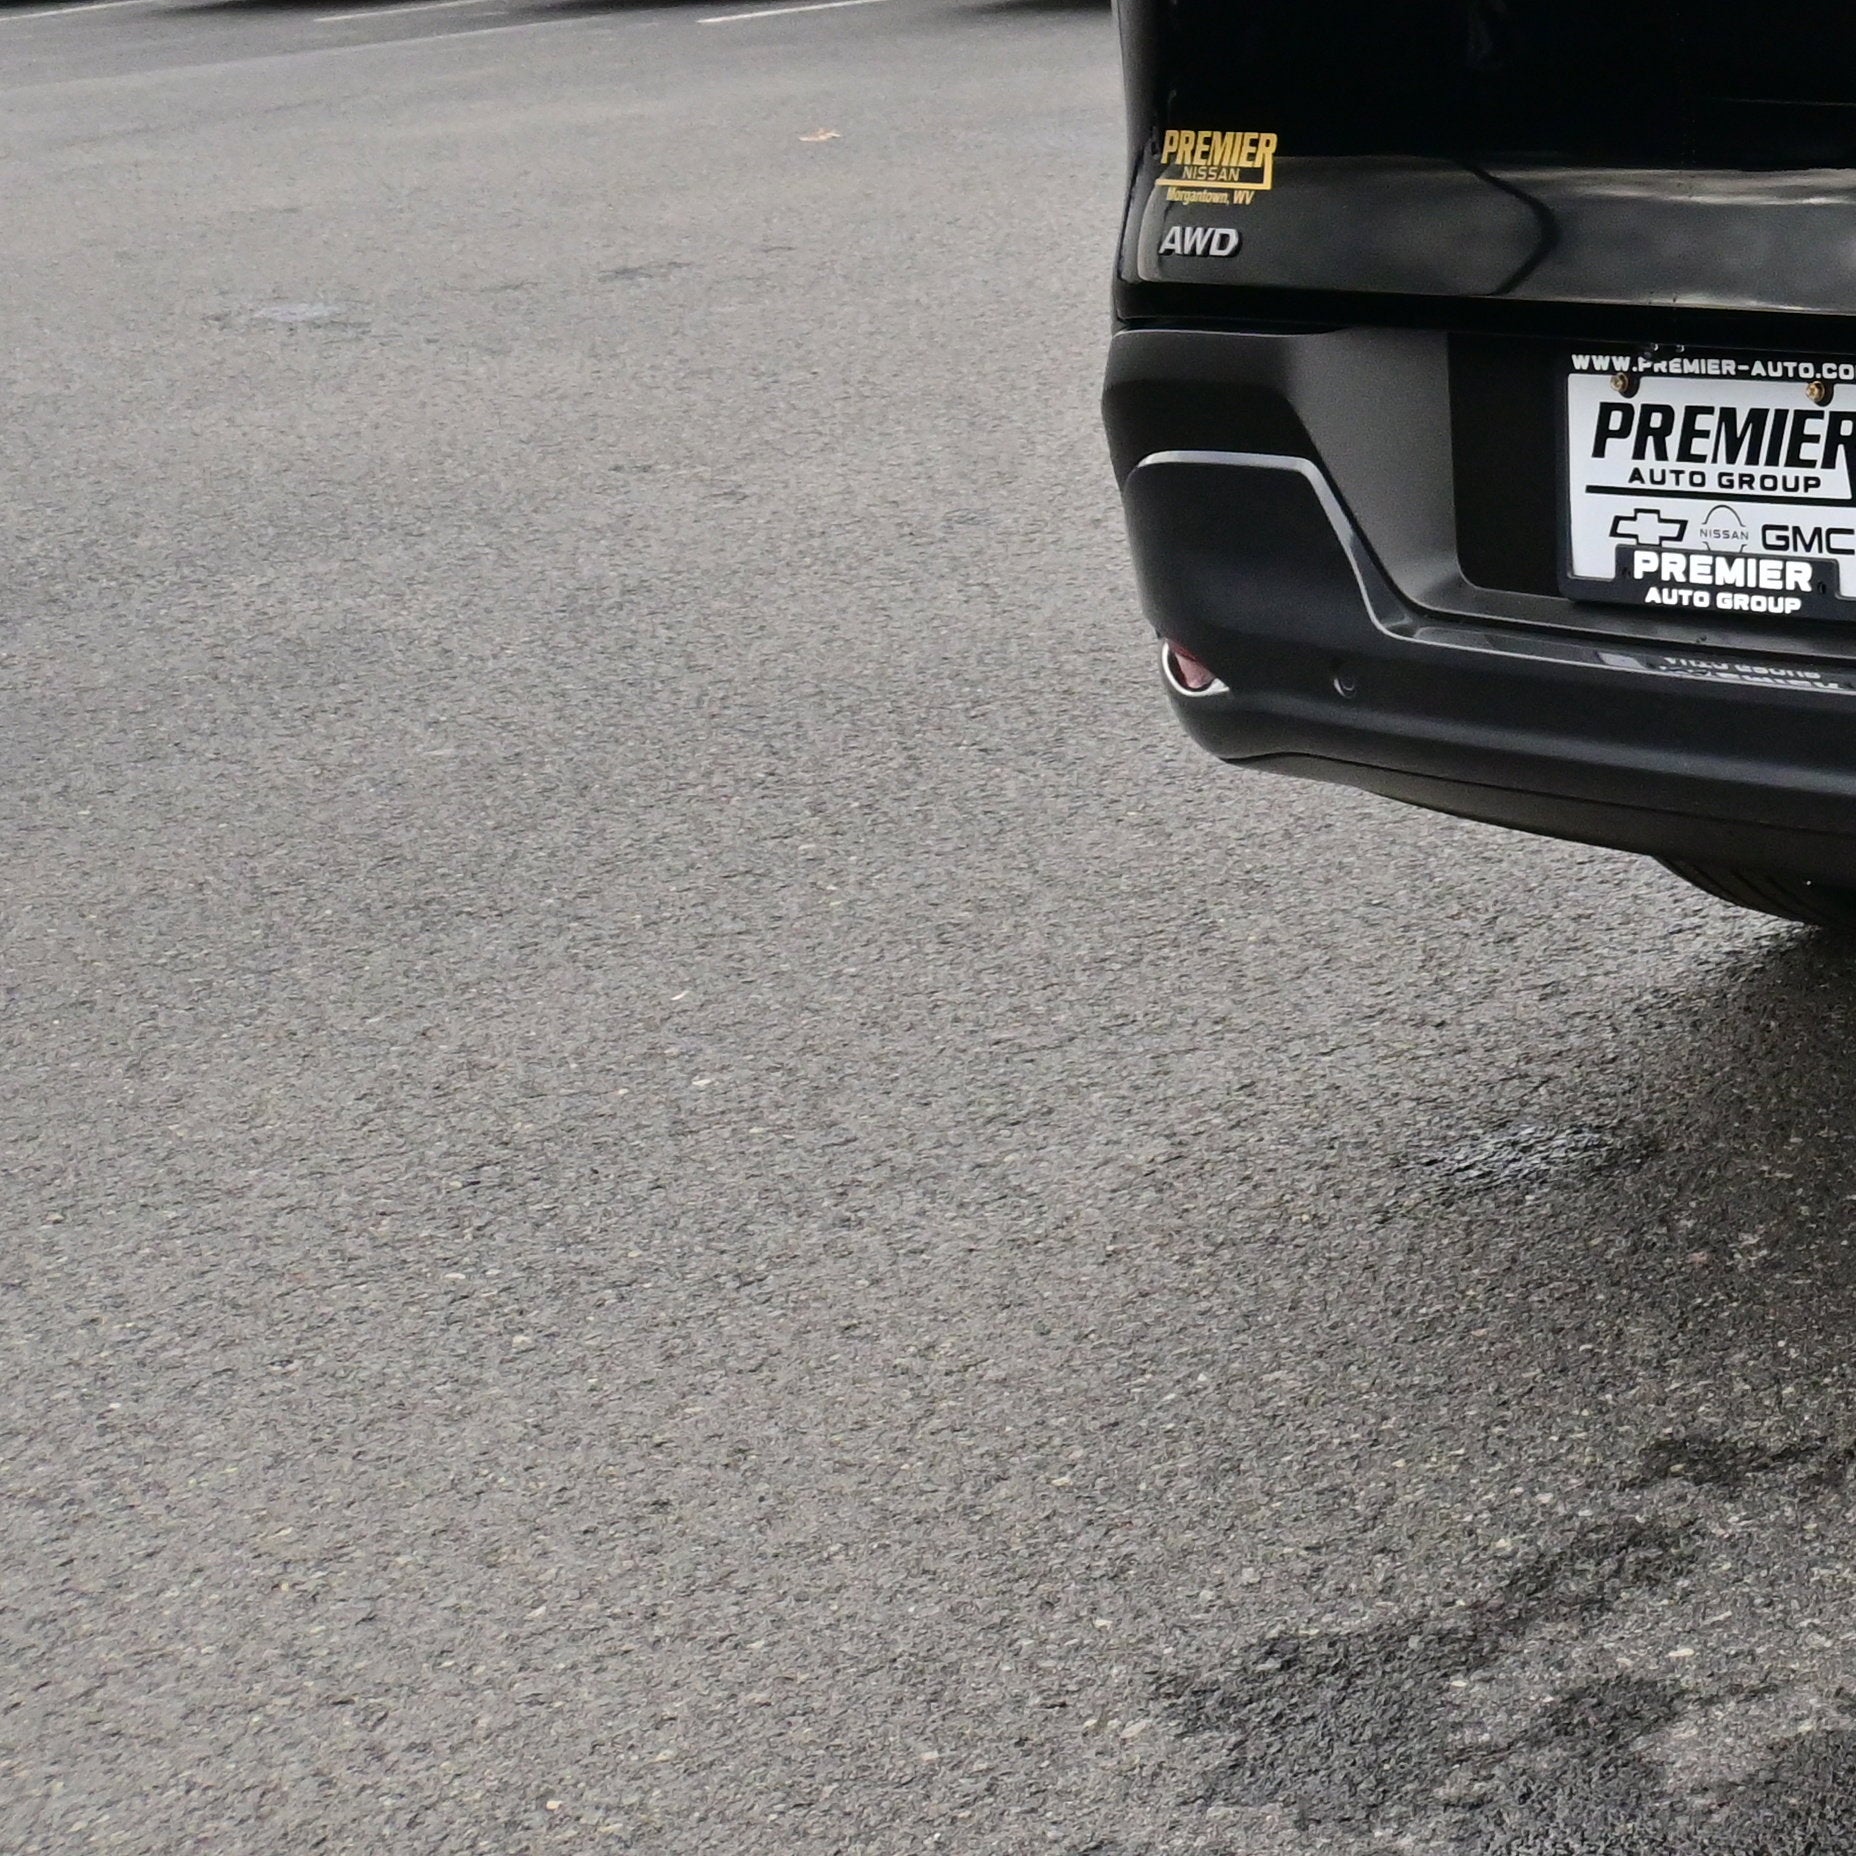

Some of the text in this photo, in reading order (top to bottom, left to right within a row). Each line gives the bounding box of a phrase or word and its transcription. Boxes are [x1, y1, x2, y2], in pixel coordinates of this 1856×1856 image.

[1160, 129, 1278, 168] PREMIER
[1181, 165, 1240, 181] NISSAN
[1166, 187, 1255, 205] Morgantown, WV
[1158, 225, 1240, 257] AWD
[1628, 467, 1821, 493] AUTO GROUP
[1699, 524, 1856, 556] NISSAN GMC
[1633, 550, 1813, 592] PREMIER
[1644, 587, 1801, 614] AUTO GROUP
